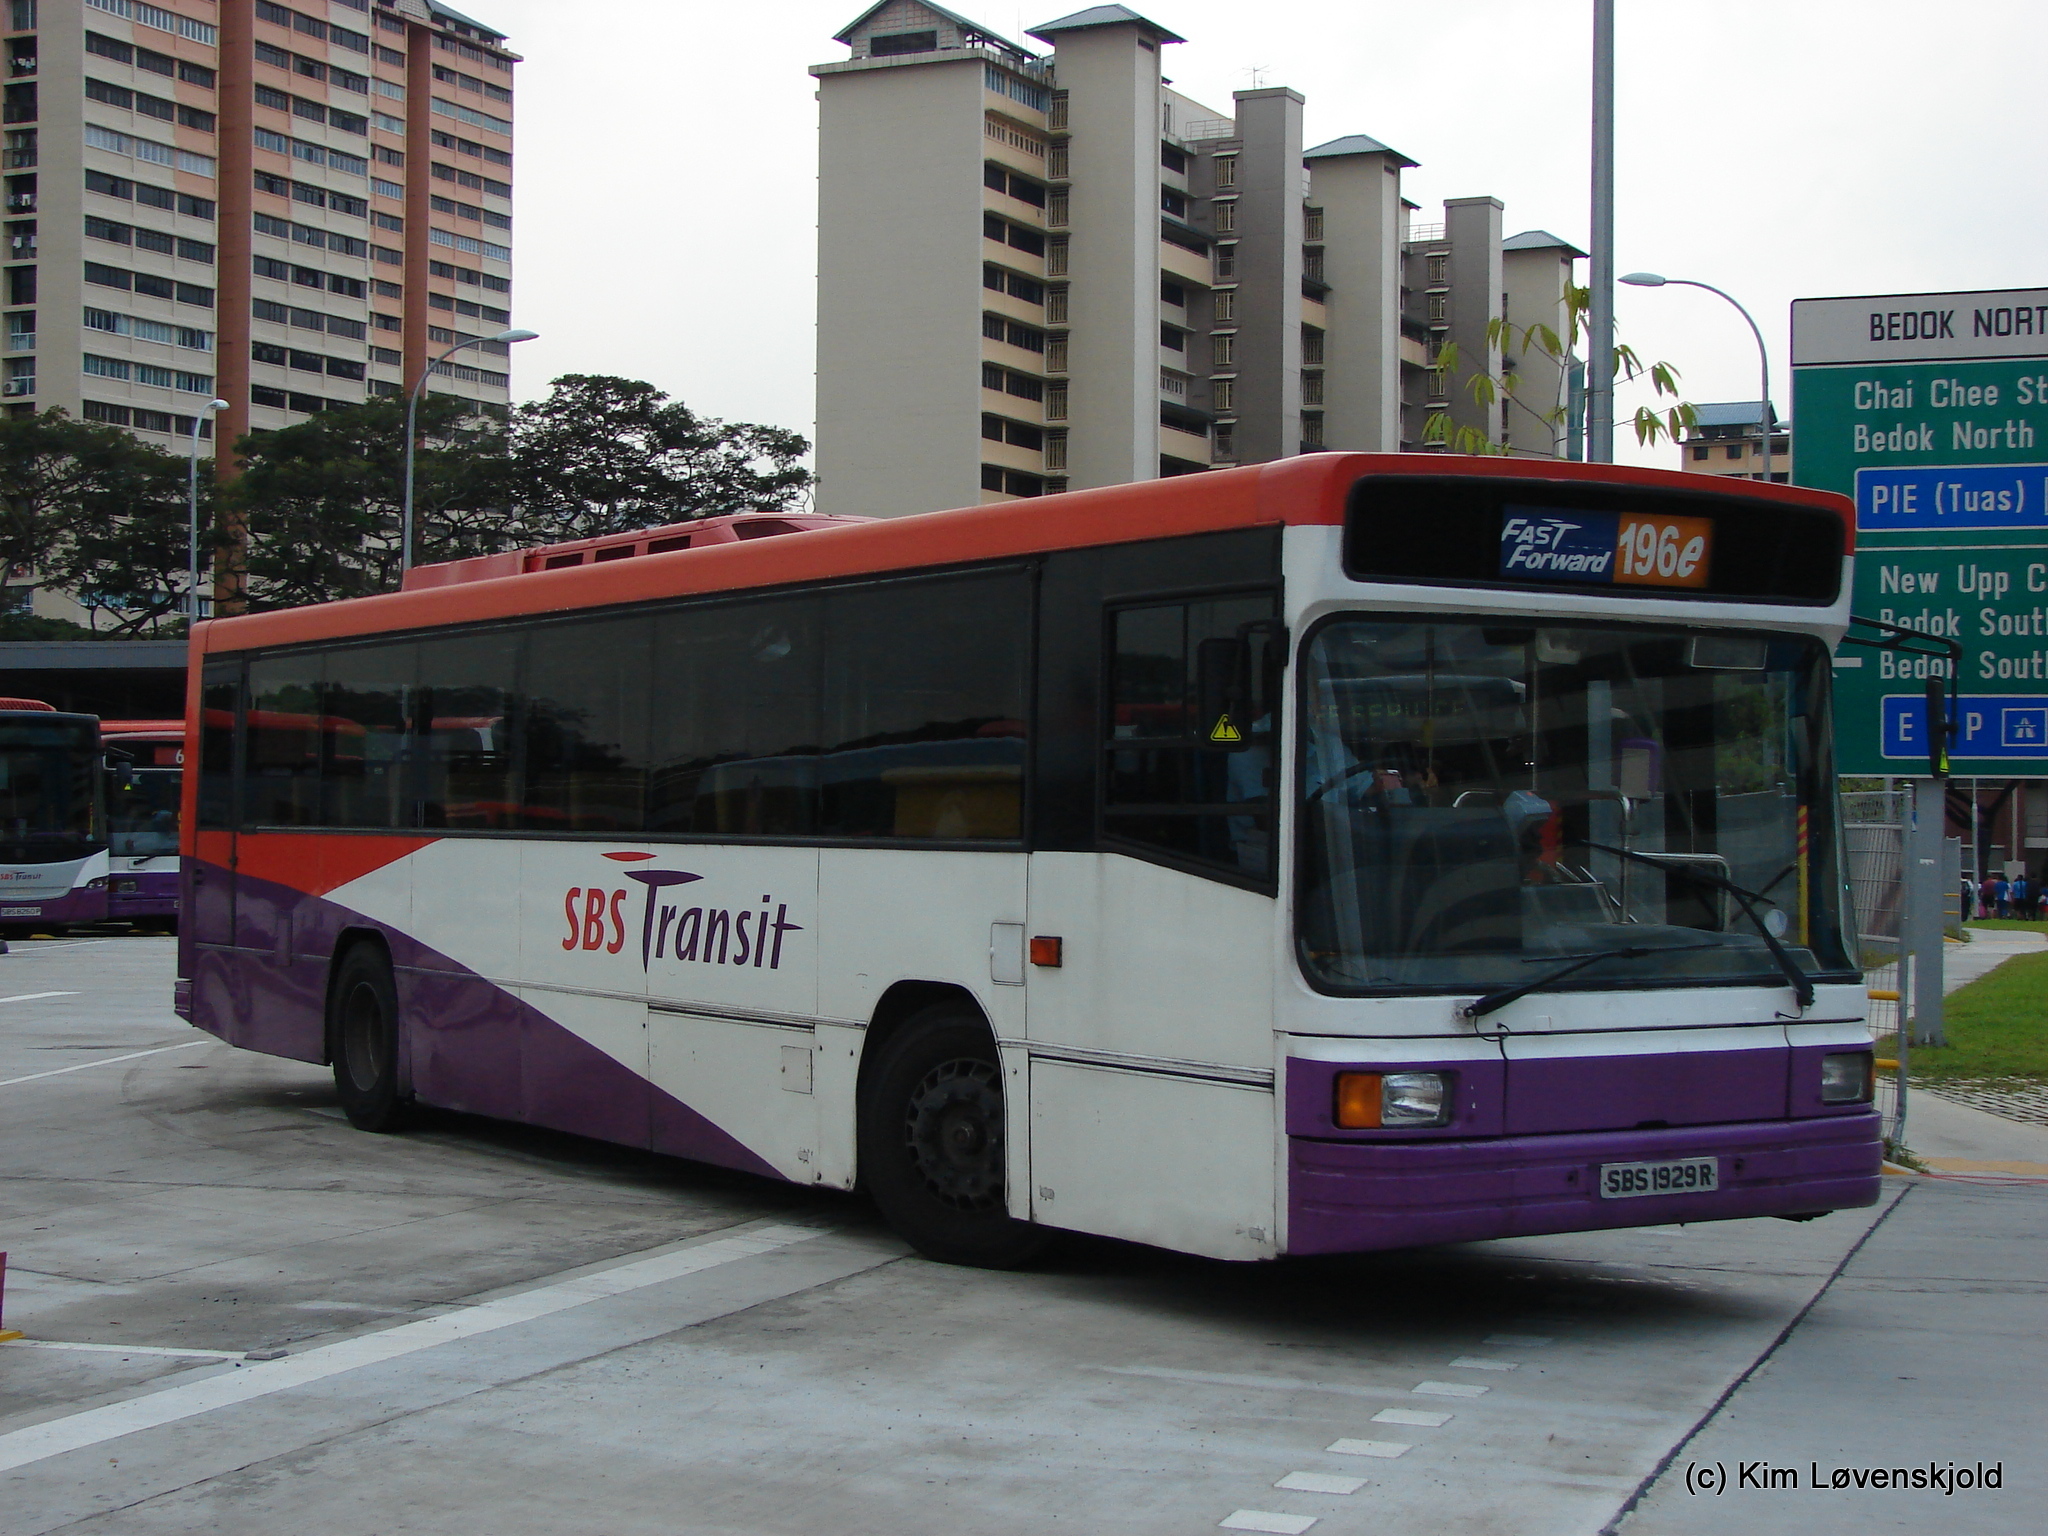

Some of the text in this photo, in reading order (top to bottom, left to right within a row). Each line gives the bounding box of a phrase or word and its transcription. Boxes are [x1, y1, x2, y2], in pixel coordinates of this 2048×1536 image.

[1870, 310, 1954, 341] BEDOK
[1854, 375, 2048, 409] Chai Chee St
[1854, 419, 2034, 452] Bedok North
[1872, 480, 2025, 515] PIE (Tuas)
[1507, 544, 1611, 573] Forward
[1618, 522, 1705, 578] 196e
[1880, 565, 1939, 594] New
[1958, 564, 2009, 600] Upp
[1880, 606, 2048, 637] Bedok Sout
[1979, 650, 2048, 680] Sout
[562, 870, 805, 974] SBS Transit
